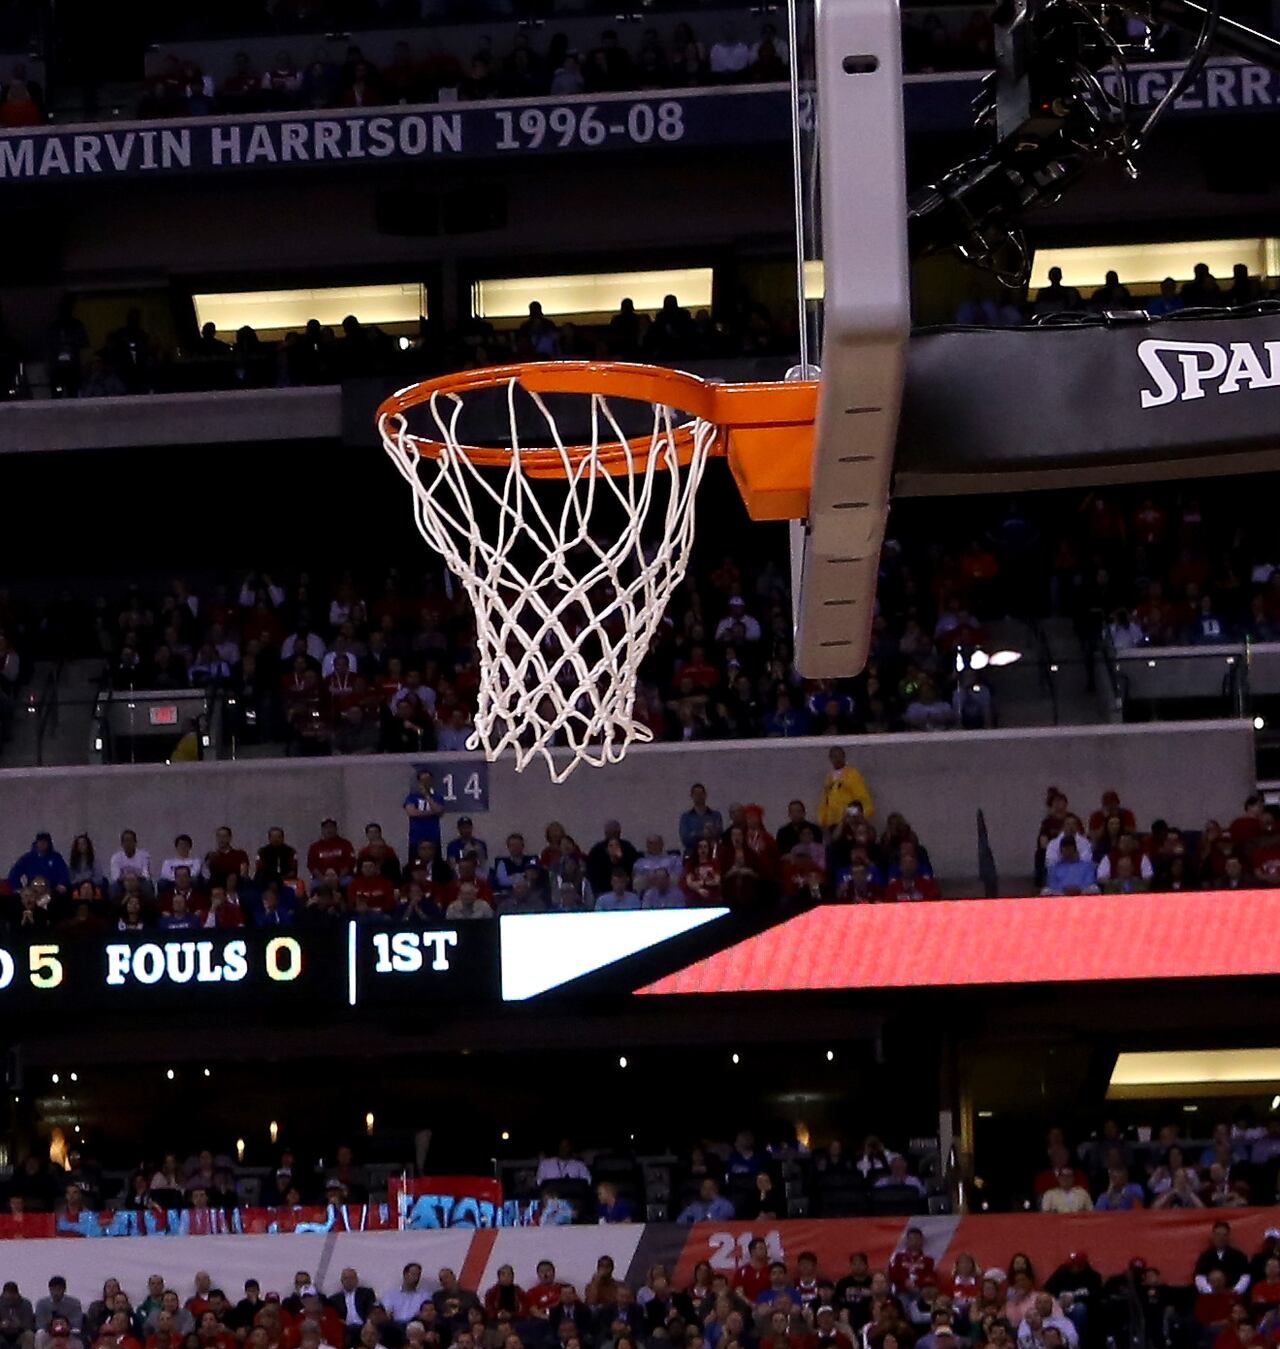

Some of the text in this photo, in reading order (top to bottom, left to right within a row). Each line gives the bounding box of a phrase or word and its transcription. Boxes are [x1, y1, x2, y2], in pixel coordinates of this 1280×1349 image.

[210, 113, 463, 165] HARRISON
[495, 102, 686, 151] 1996-08
[442, 772, 482, 800] 14
[29, 945, 63, 988] 5
[106, 940, 248, 985] FOULS
[265, 937, 302, 981] 0
[373, 931, 457, 972] 1ST
